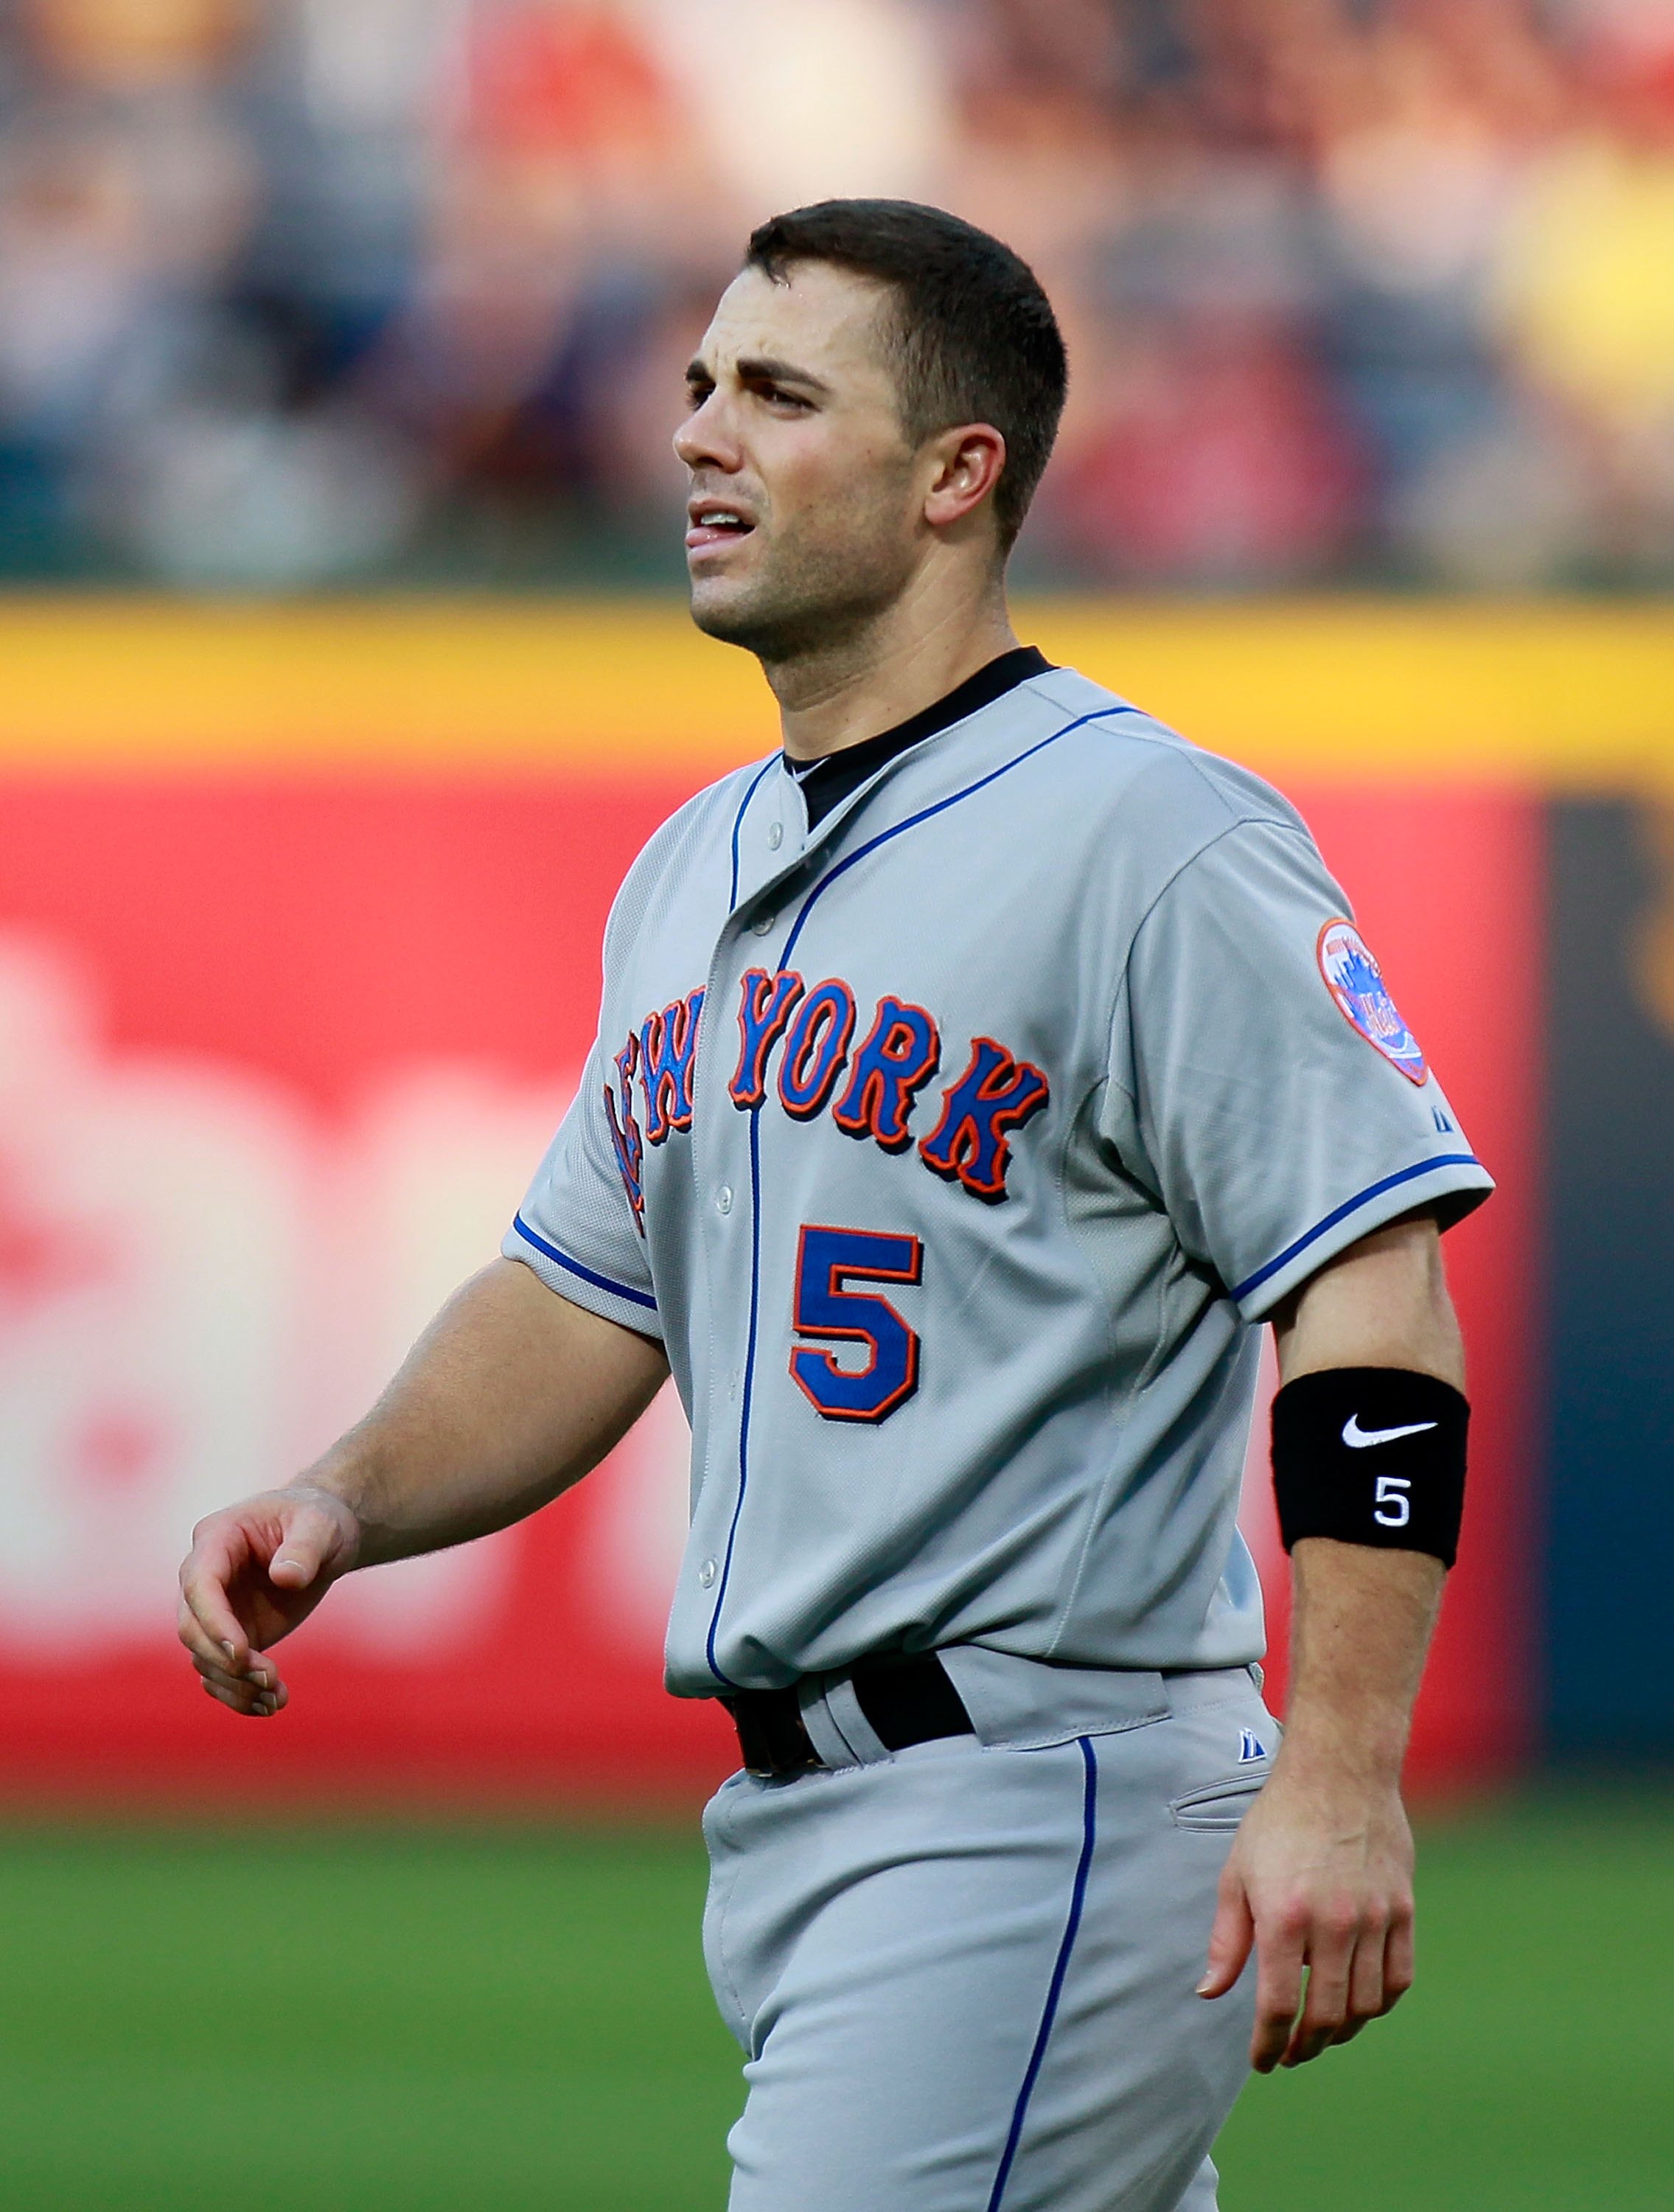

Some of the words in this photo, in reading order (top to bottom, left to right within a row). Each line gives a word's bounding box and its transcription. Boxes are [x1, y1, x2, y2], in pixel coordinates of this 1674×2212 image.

[728, 967, 1049, 1205] YORK
[788, 1223, 924, 1425] 5
[1374, 1476, 1411, 1527] 5
